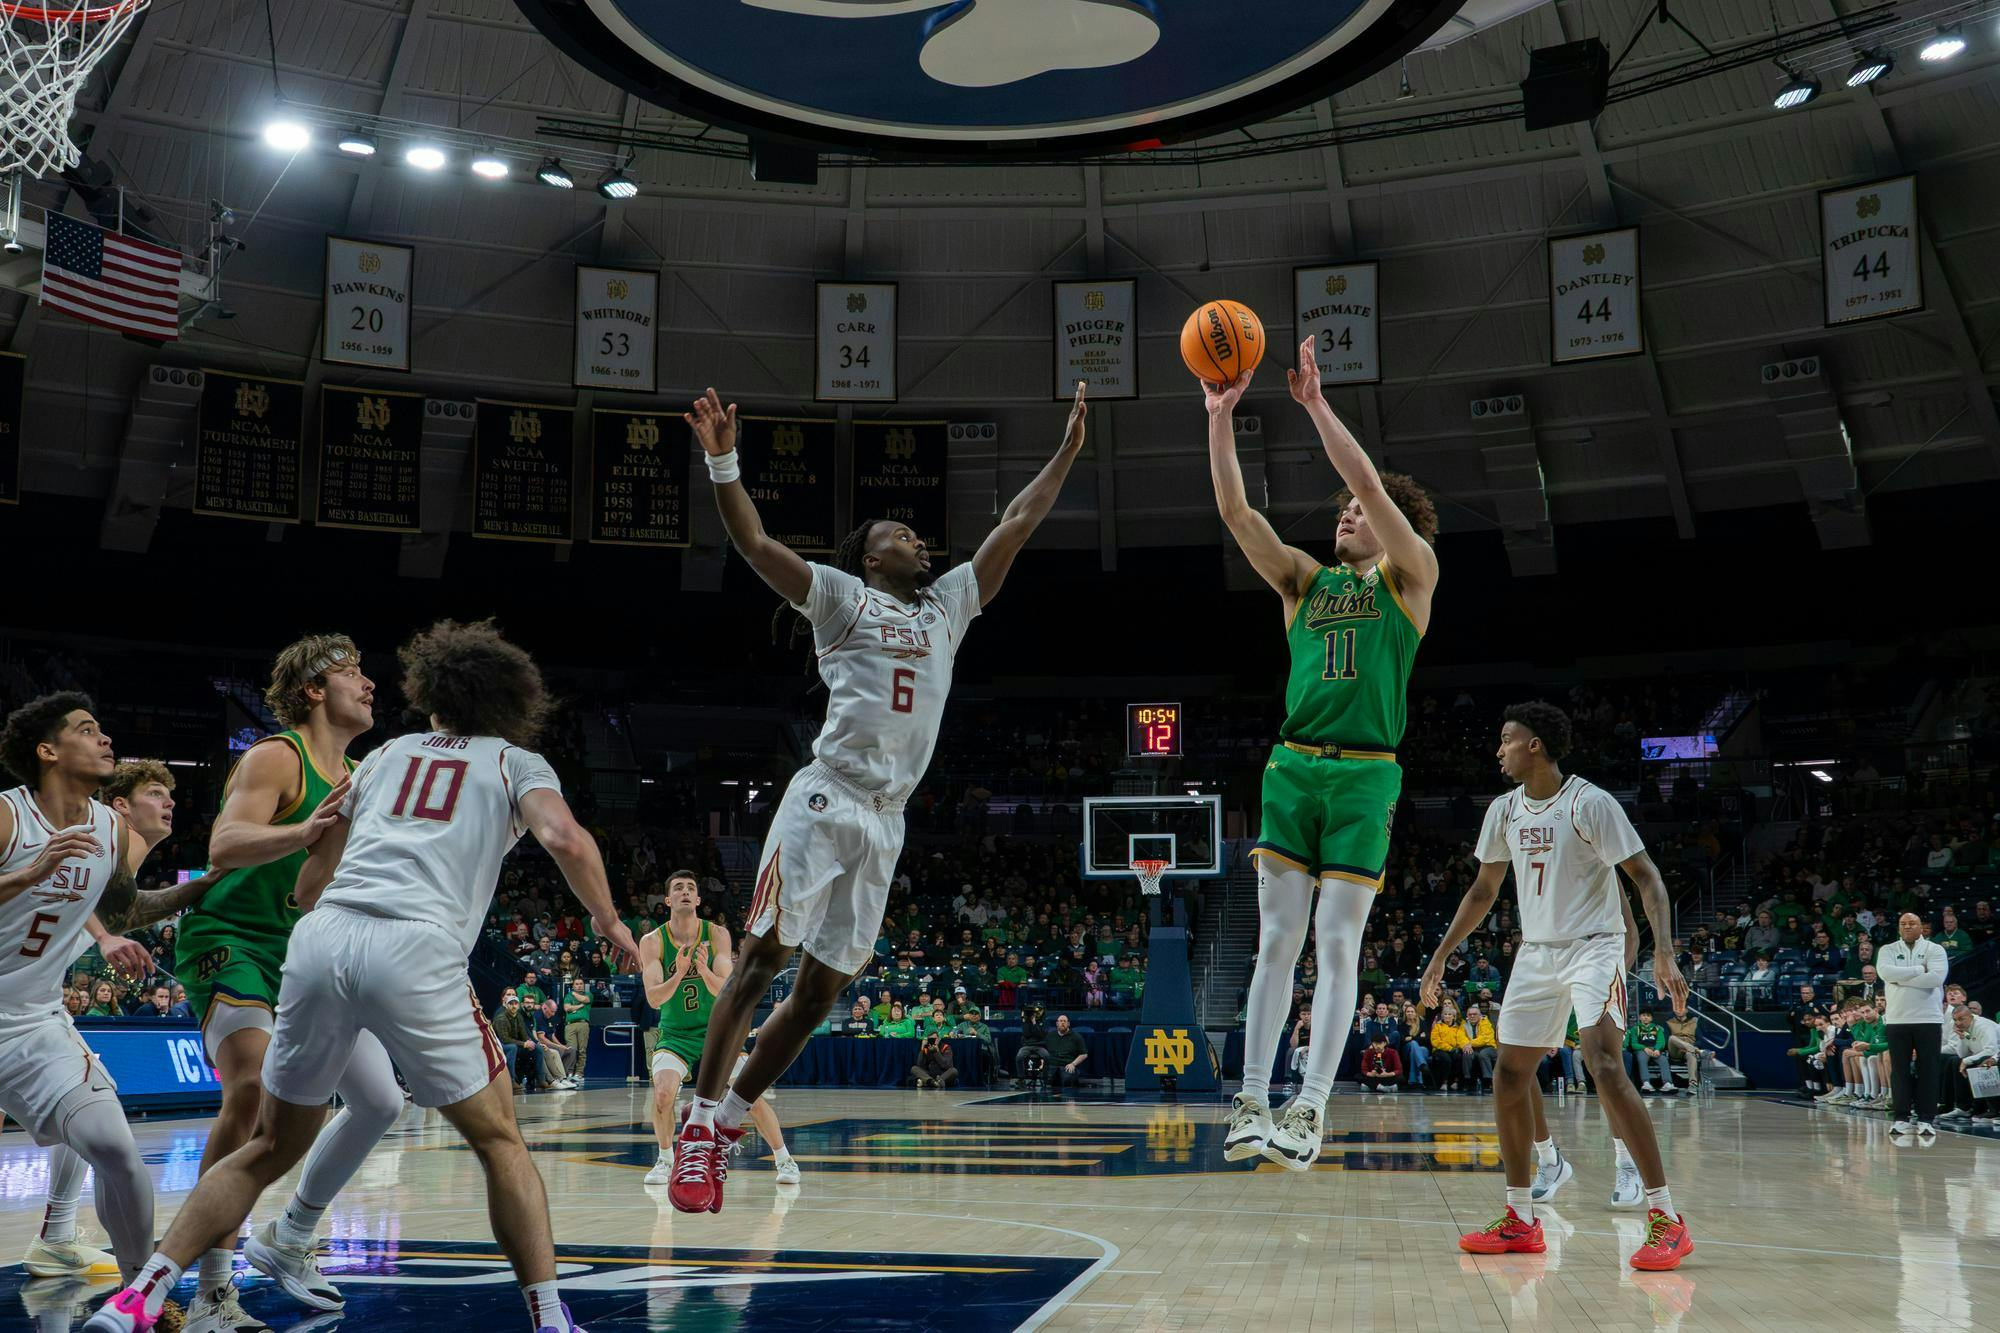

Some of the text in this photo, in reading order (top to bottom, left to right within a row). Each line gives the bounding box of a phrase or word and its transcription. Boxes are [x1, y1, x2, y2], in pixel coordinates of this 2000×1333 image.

[1830, 224, 1909, 251] TRIPUCKA
[1853, 250, 1890, 282] 44
[1556, 273, 1633, 296] DANTLEY
[331, 282, 405, 303] HAWKINS
[1846, 294, 1868, 307] 1977
[582, 308, 651, 327] WHITMORE
[1302, 304, 1371, 322] SHUMATE
[1577, 297, 1612, 324] 44
[351, 306, 383, 333] 20
[1065, 319, 1125, 334] DIGGER
[837, 322, 875, 334] CARR
[1208, 307, 1232, 362] Wilson
[600, 332, 629, 357] 53
[1070, 333, 1122, 347] PHELPS
[1321, 326, 1352, 353] 34
[1569, 336, 1592, 347] 1973
[1601, 332, 1624, 343] 1976
[341, 341, 362, 352] 1956
[372, 345, 393, 355] 1959
[839, 345, 871, 369] 34
[591, 366, 611, 375] 1966
[620, 368, 640, 378] 1969
[1343, 362, 1363, 371] 1974
[860, 380, 880, 389] 1971
[231, 420, 271, 434] NCAA
[201, 432, 296, 449] TOURNAMENT
[352, 433, 393, 447] NCAA
[325, 445, 416, 461] TOURNAMENT
[506, 446, 544, 459] NCAA
[623, 454, 662, 466] NCAA
[492, 459, 559, 473] SWEET 16
[611, 466, 658, 477] ELITE
[769, 460, 807, 472] NCAA
[882, 465, 919, 474] NCAA
[759, 473, 817, 485] ELITE 8
[860, 476, 940, 487] FINAL FOUR
[604, 482, 679, 496] 1953 1954
[751, 487, 779, 501] 2016
[207, 497, 288, 513] MEN'S BASKETBALL
[604, 496, 679, 512] 1958 1978
[328, 509, 410, 524] MEN'S BASKETBALL
[604, 511, 679, 526] 1979 2015
[886, 507, 915, 519] 1978
[483, 520, 563, 535] MEN'S BASKETBALL
[601, 526, 680, 540] MEN'S BASKETBALL
[776, 534, 826, 545] BASKETBALL
[1306, 583, 1382, 624] Irish
[880, 625, 932, 647] FSU
[1322, 629, 1357, 680] 11
[891, 668, 916, 714] 6
[1139, 709, 1175, 723] 10:54
[422, 736, 472, 750] JONES
[1149, 725, 1171, 751] 12
[391, 756, 470, 824] 10
[1519, 827, 1554, 845] FSU
[52, 865, 90, 890] SU
[1531, 862, 1545, 896] 7
[19, 912, 60, 958] 5
[683, 984, 699, 1012] 2
[1645, 991, 1654, 1000] 16
